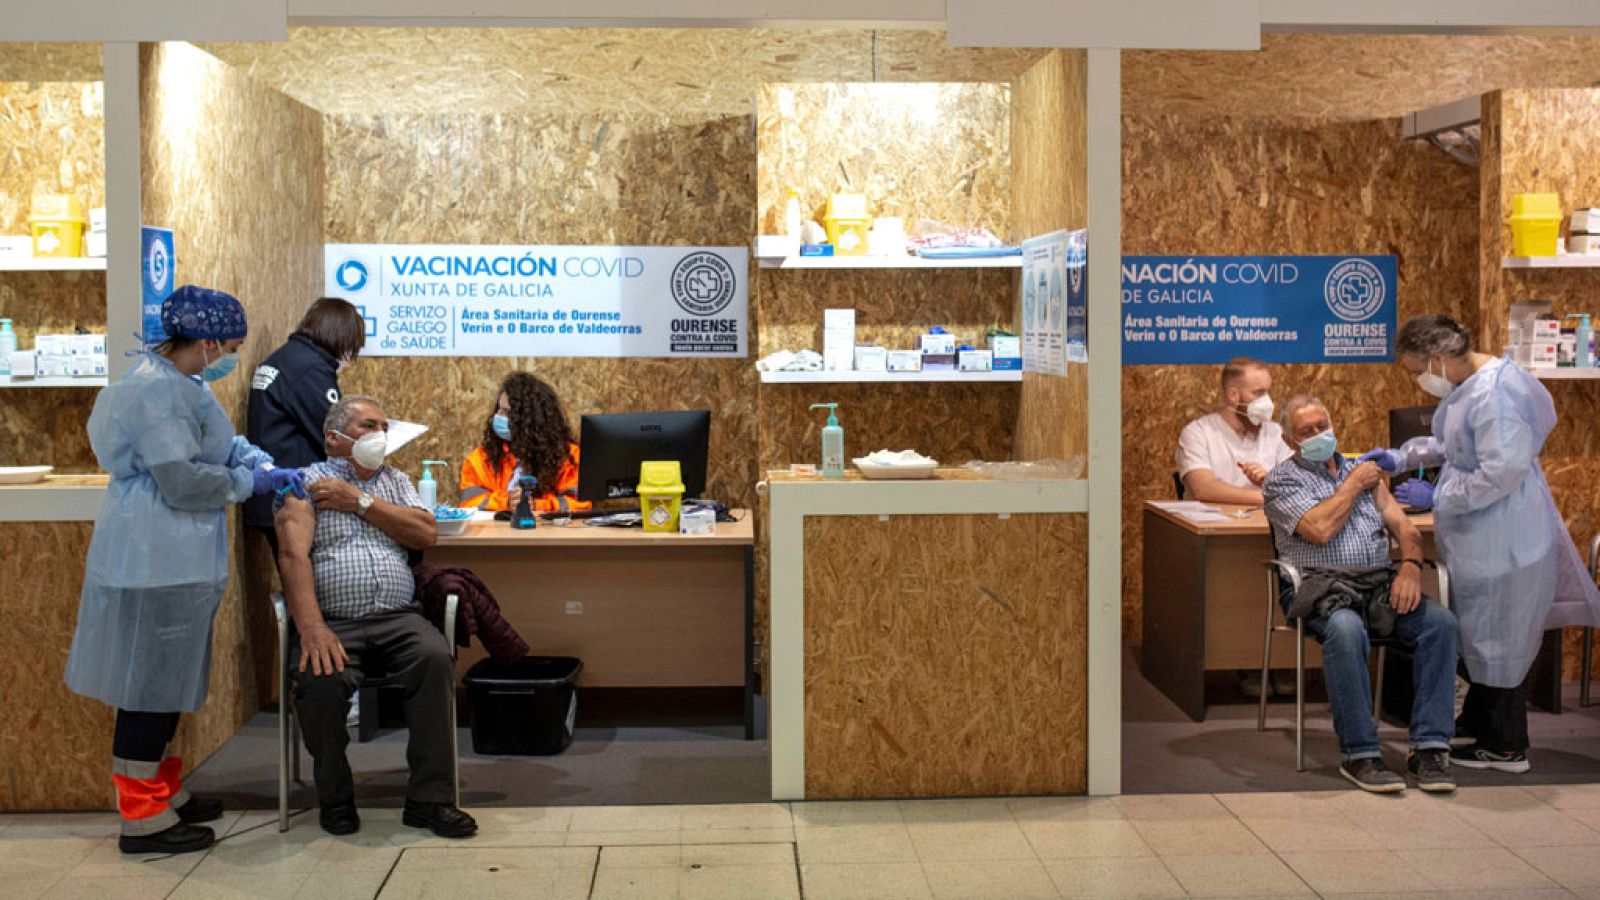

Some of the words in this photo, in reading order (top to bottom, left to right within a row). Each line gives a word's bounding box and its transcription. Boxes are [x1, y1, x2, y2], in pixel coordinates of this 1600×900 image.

[391, 252, 557, 276] VACINACIÓN
[564, 257, 644, 278] COVID
[1122, 258, 1218, 284] NACIÓN
[1222, 263, 1299, 284] COVID
[391, 282, 450, 297] XUNTA
[456, 282, 478, 297] DE
[484, 282, 554, 298] GALICIA
[1122, 289, 1142, 304] DE
[1148, 289, 1214, 304] GALICIA
[390, 306, 447, 318] SERVIZO
[462, 308, 490, 320] Área
[494, 309, 548, 320] Sanitaria
[552, 309, 567, 320] de
[572, 310, 621, 320] Ourense
[671, 319, 737, 332] OURENSE
[1125, 314, 1152, 327] Área
[1156, 316, 1209, 327] Sanitaria
[1212, 316, 1226, 327] de
[1230, 316, 1278, 327] Ourense
[387, 321, 447, 334] GALEGO
[496, 324, 504, 333] e
[520, 322, 555, 334] Barco
[559, 322, 573, 334] de
[578, 322, 642, 334] Valdeorras
[1324, 324, 1386, 337] OURENSE
[380, 335, 397, 348] de
[400, 334, 447, 348] SAÚDE
[670, 334, 703, 342] CONTRA
[704, 334, 712, 342] A
[713, 334, 738, 342] COVID
[1158, 332, 1166, 342] e
[1181, 330, 1215, 342] Barco
[1218, 330, 1232, 341] de
[1236, 330, 1298, 341] Valdeorras
[94, 346, 102, 354] M
[945, 346, 954, 354] M
